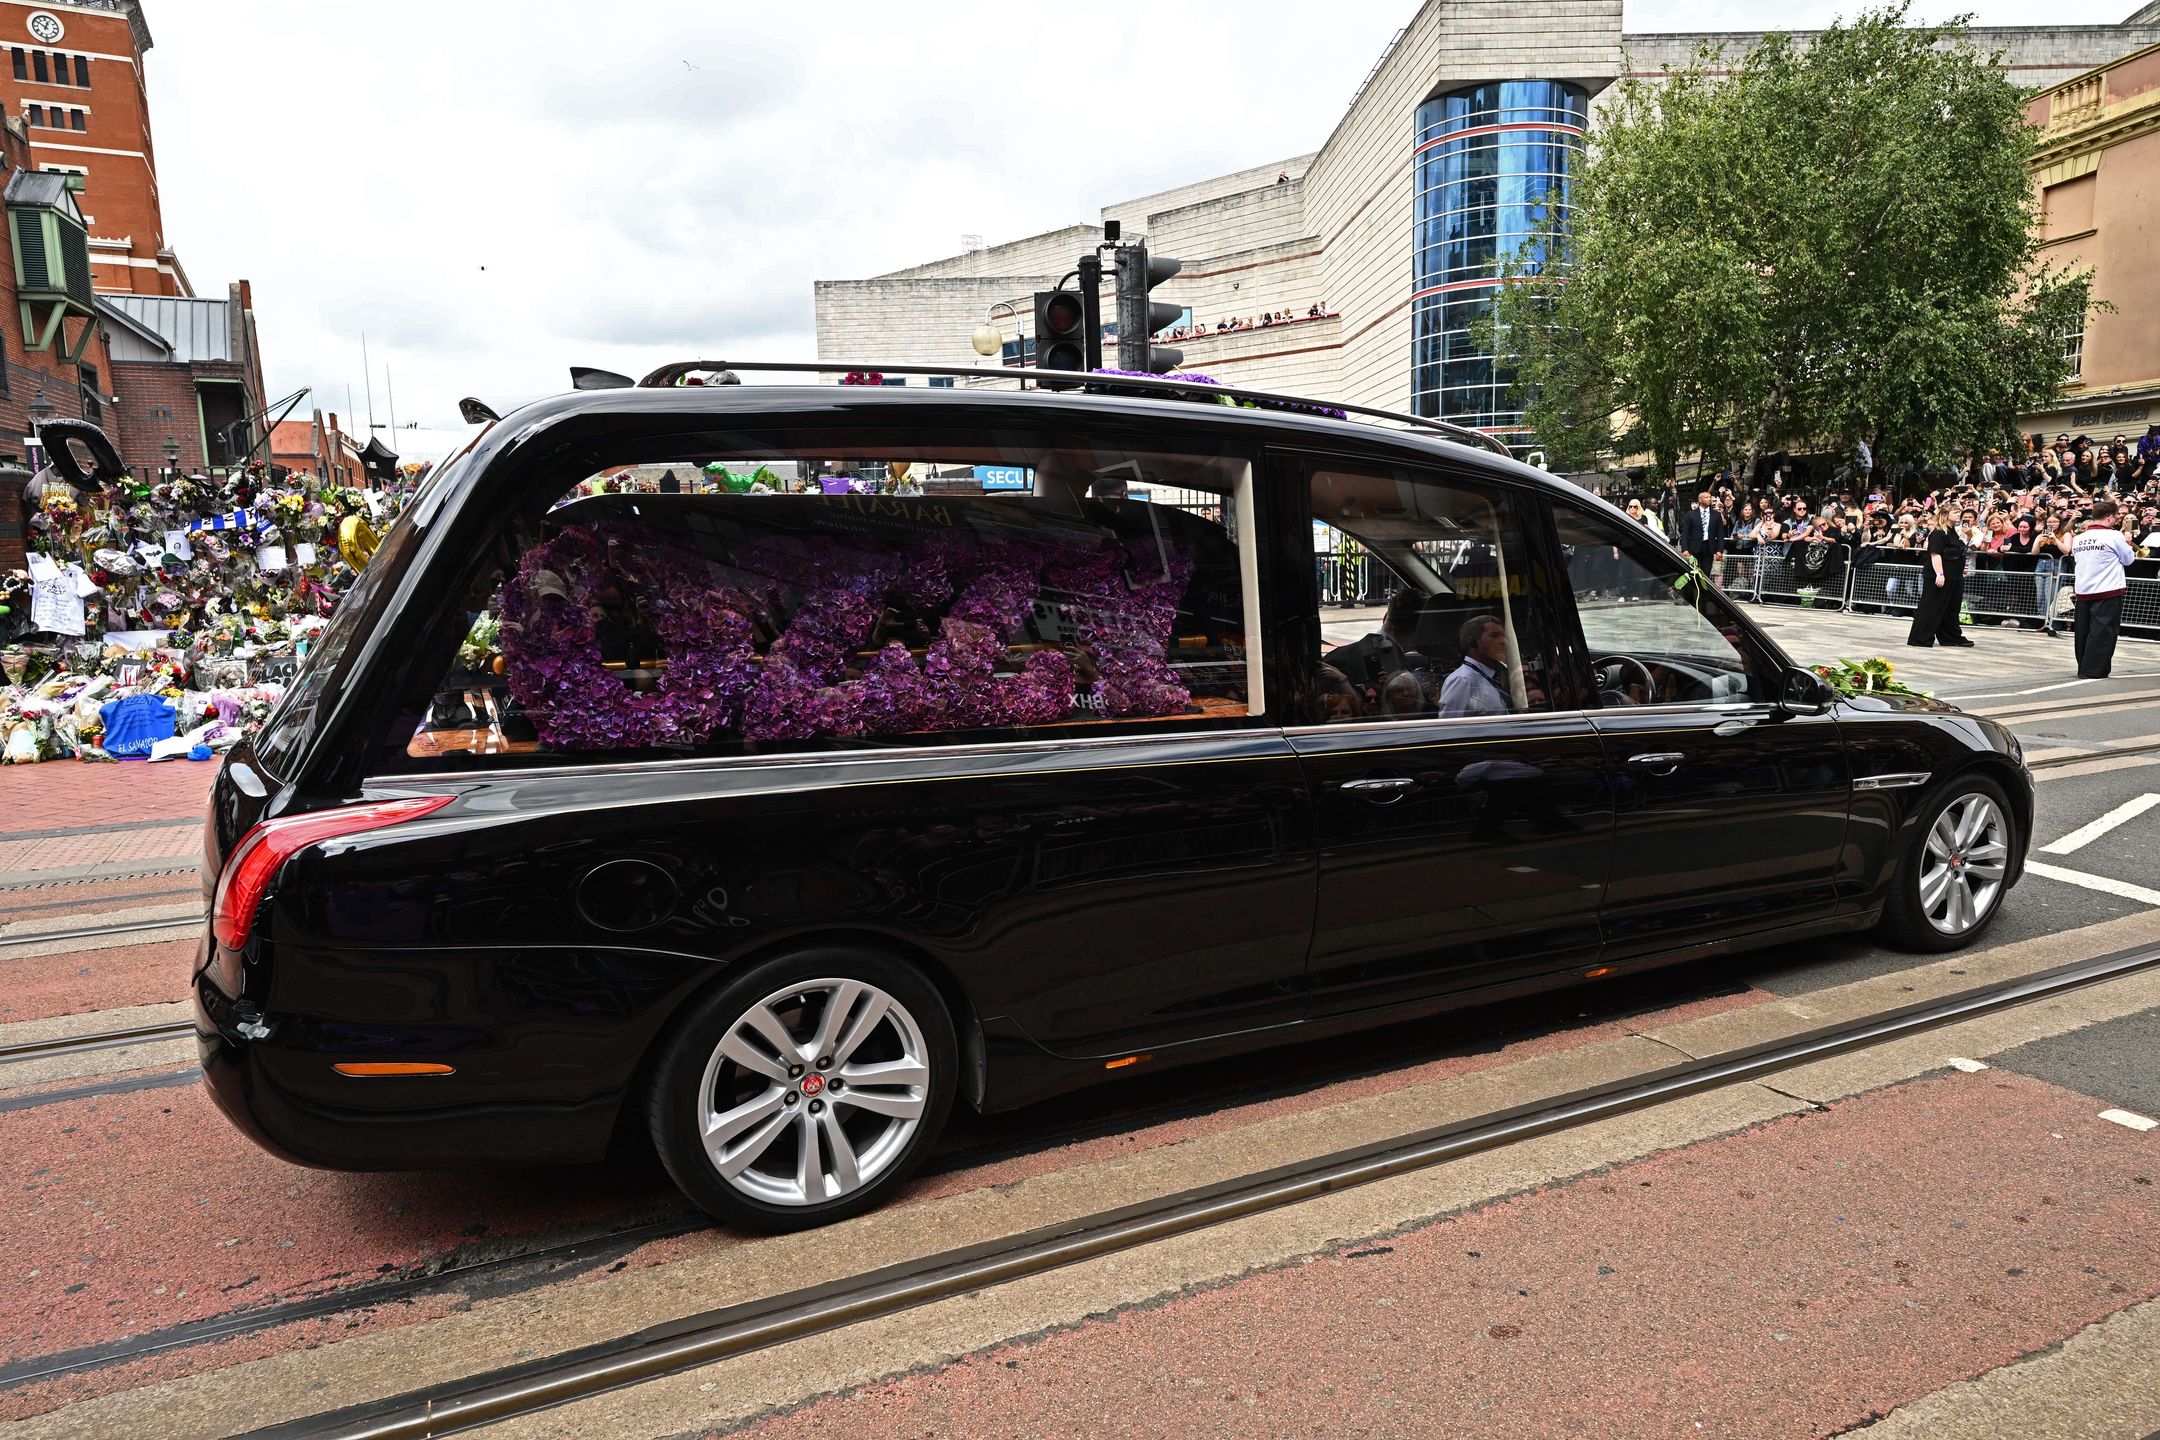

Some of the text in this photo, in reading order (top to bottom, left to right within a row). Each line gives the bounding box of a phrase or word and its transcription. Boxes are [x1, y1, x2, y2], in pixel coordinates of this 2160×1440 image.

[2072, 407, 2150, 427] BEER GARDEN
[2079, 538, 2098, 546] OZZY
